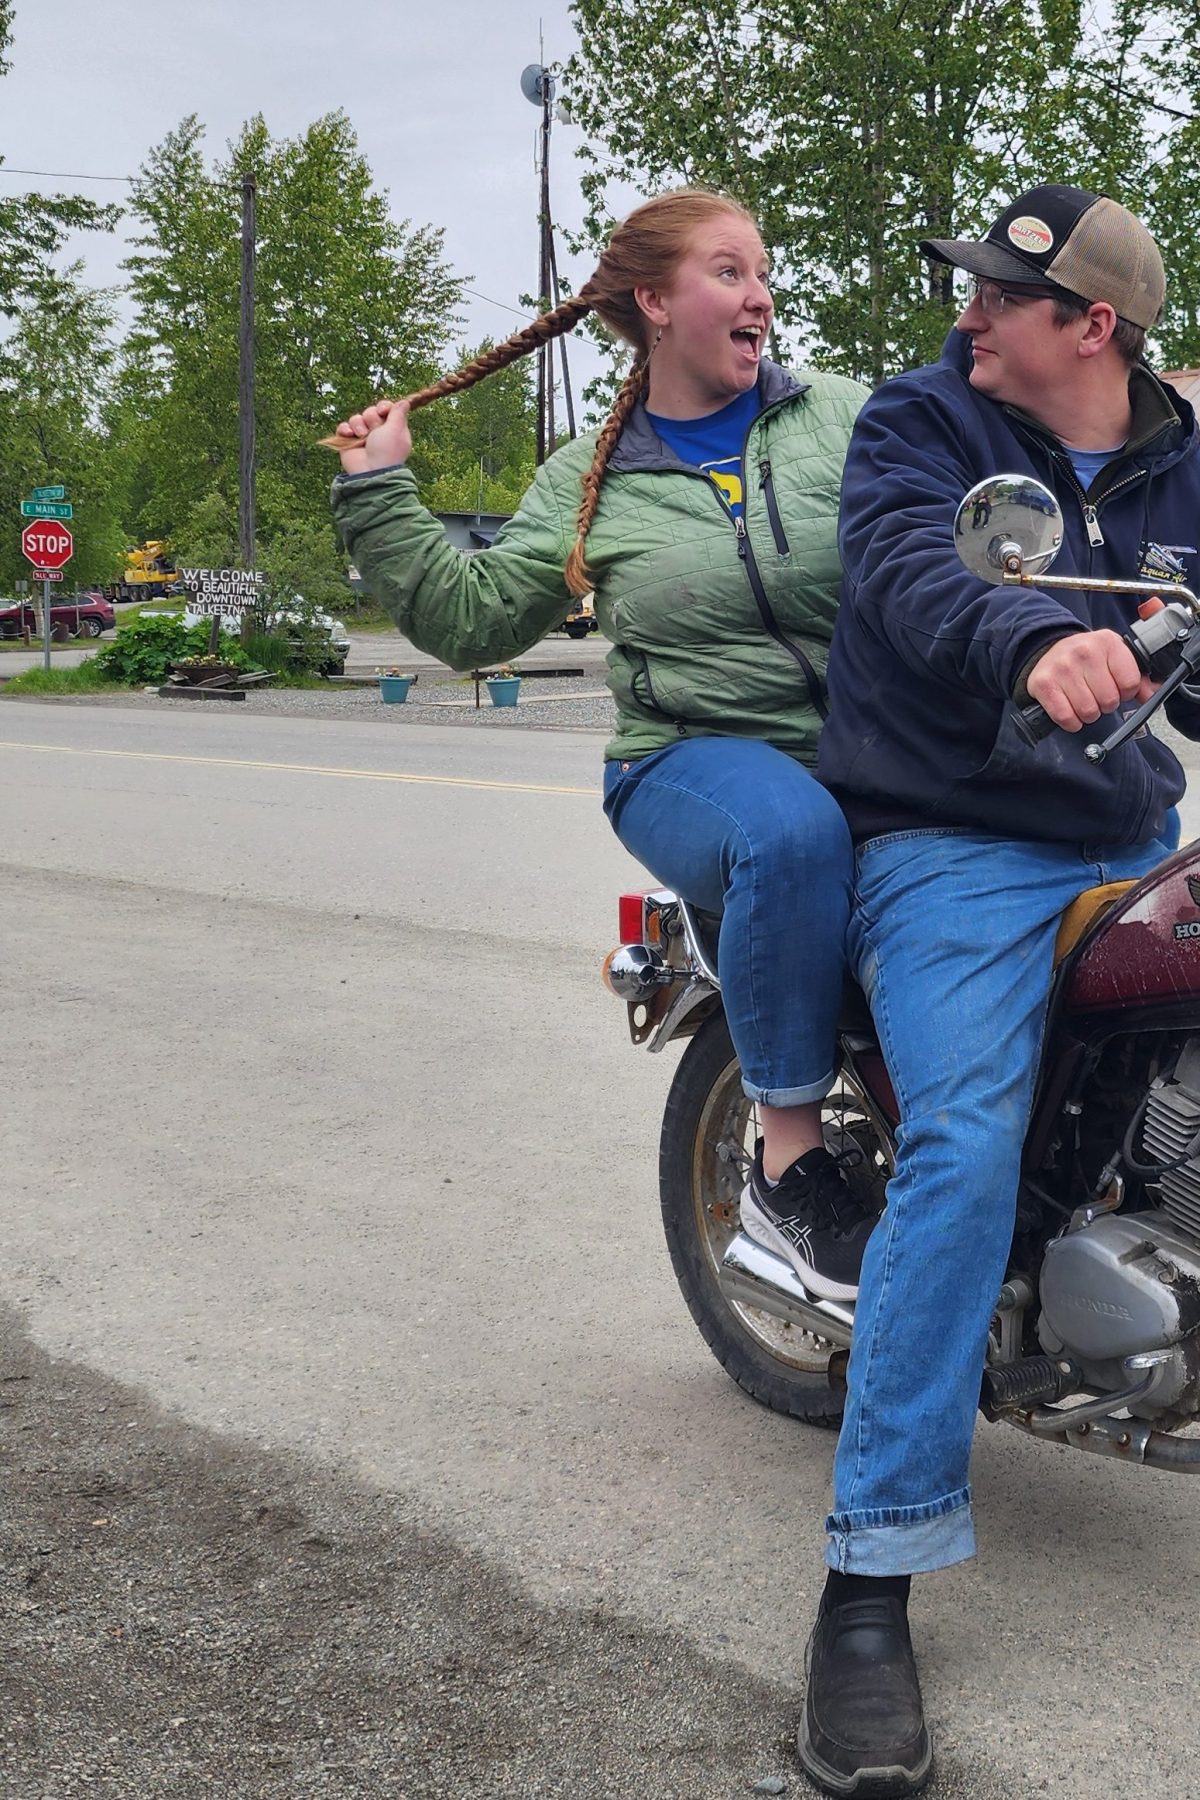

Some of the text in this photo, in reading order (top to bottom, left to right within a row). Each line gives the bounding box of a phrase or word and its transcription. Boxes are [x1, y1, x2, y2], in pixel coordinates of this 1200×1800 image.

[26, 505, 31, 513] E
[35, 504, 56, 514] MAIN
[26, 534, 69, 554] STOP
[182, 568, 264, 583] WELCOME
[184, 580, 259, 596] TO BEAUTIFUL
[196, 592, 256, 606] DOWNTOWN
[189, 603, 247, 617] TALKEETNA
